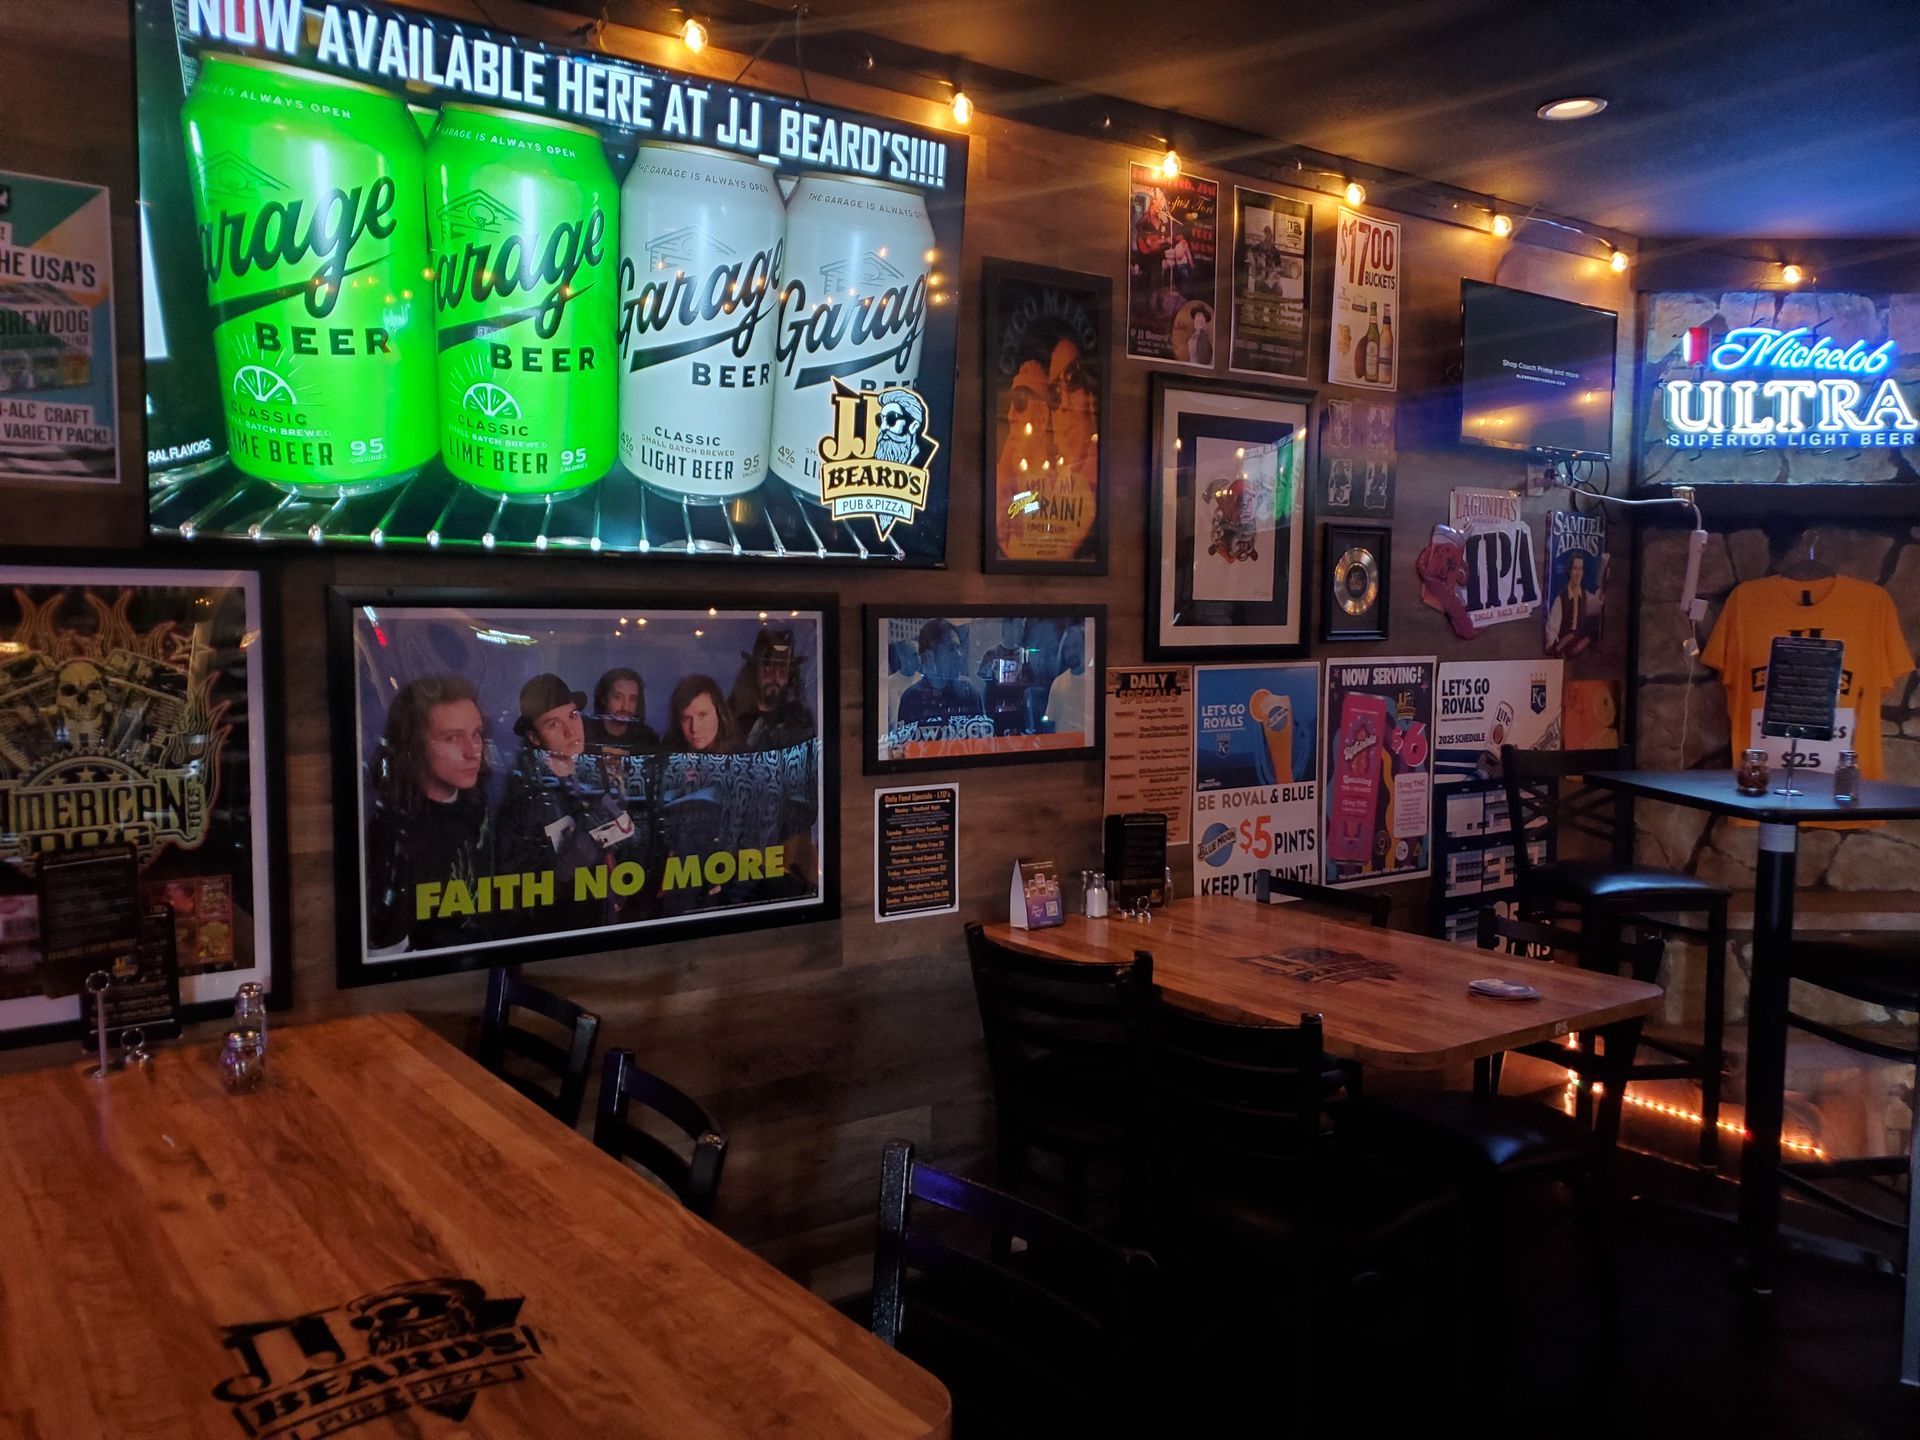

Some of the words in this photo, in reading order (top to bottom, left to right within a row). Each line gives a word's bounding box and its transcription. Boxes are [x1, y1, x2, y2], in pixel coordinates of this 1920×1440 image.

[188, 0, 301, 54] NOW
[317, 4, 546, 105] AVAILABLE
[558, 60, 653, 129] HERE
[662, 84, 708, 137] AT
[240, 89, 304, 109] ALWAYS
[310, 102, 352, 119] OPEN
[490, 135, 542, 152] ALWAYS
[546, 145, 576, 158] OPEN
[650, 166, 686, 179] GARAGE
[690, 172, 701, 181] IS
[704, 174, 747, 190] ALWAYS
[808, 192, 822, 202] THE
[825, 194, 863, 209] GARAGE
[866, 201, 876, 211] IS
[879, 204, 913, 218] ALWAYS
[31, 254, 96, 289] USA'S
[1364, 270, 1396, 290] BUCKETS
[617, 237, 783, 359] Garage
[776, 271, 930, 377] Garag
[255, 321, 391, 356] BEER
[1711, 326, 1896, 374] Michelob
[489, 342, 595, 373] BEER
[1502, 359, 1518, 369] Shop
[1518, 362, 1537, 372] Coach
[1537, 365, 1553, 375] Prime
[1554, 369, 1565, 377] and
[691, 361, 770, 388] BEER
[44, 405, 90, 426] CRAFT
[230, 400, 308, 425] CLASSIC
[1664, 379, 1920, 434] ULTRA
[4, 424, 63, 443] VARIETY
[66, 426, 108, 445] PACK!
[280, 428, 332, 438] BREWED
[458, 414, 529, 437] CLASSIC
[654, 425, 721, 447] CLASSIC
[819, 394, 879, 462] JJ
[170, 438, 213, 459] FLAVORS
[349, 437, 385, 456] 95
[472, 432, 502, 446] BATCH
[504, 438, 548, 449] BREWED
[641, 434, 667, 449] SMALL
[669, 443, 697, 455] BATCH
[699, 449, 735, 457] BREWED
[1669, 433, 1777, 448] SUPERIOR
[1787, 433, 1850, 447] LIGHT
[1860, 432, 1916, 446] BEER
[269, 439, 334, 467] BEER
[450, 438, 484, 468] LIME
[493, 450, 549, 475] BEER
[560, 447, 587, 466] 95
[641, 445, 687, 476] LIGHT
[692, 459, 734, 480] BEER
[743, 453, 760, 471] 95
[777, 445, 796, 464] 4%
[827, 464, 923, 495] BEARD'S
[1031, 495, 1083, 528] RAIN!
[1456, 493, 1518, 521] LAGUNITAS
[1553, 511, 1605, 538] SAMUEL
[1556, 534, 1600, 559] ADAMS
[1465, 529, 1538, 612] IPA
[1473, 611, 1494, 622] INDIA
[1129, 673, 1169, 690] DAILY
[1341, 666, 1370, 686] NOW
[1372, 665, 1423, 685] SERVING!
[1118, 688, 1179, 705] SPECIALS
[1442, 679, 1472, 697] LET'S
[1474, 678, 1490, 695] GO
[1202, 704, 1227, 717] LET'S
[1230, 703, 1245, 715] GO
[1442, 696, 1485, 715] ROYALS
[1496, 708, 1511, 726] Lite
[1203, 716, 1244, 729] ROYALS
[1391, 722, 1428, 767] $6
[1438, 735, 1454, 745] 2025
[1455, 733, 1486, 744] SCHEDULE
[0, 775, 188, 834] MERICAN
[899, 793, 911, 803] Food
[1199, 796, 1216, 811] BE
[1222, 790, 1267, 809] ROYAL
[1270, 788, 1279, 803] &
[1283, 785, 1315, 803] BLUE
[1217, 830, 1236, 846] MOON
[1239, 815, 1273, 859] $5
[1275, 829, 1315, 855] PINTS
[415, 870, 555, 921] FAITH
[573, 860, 646, 902] NO
[662, 844, 786, 892] MORE
[1202, 874, 1239, 897] KEEP
